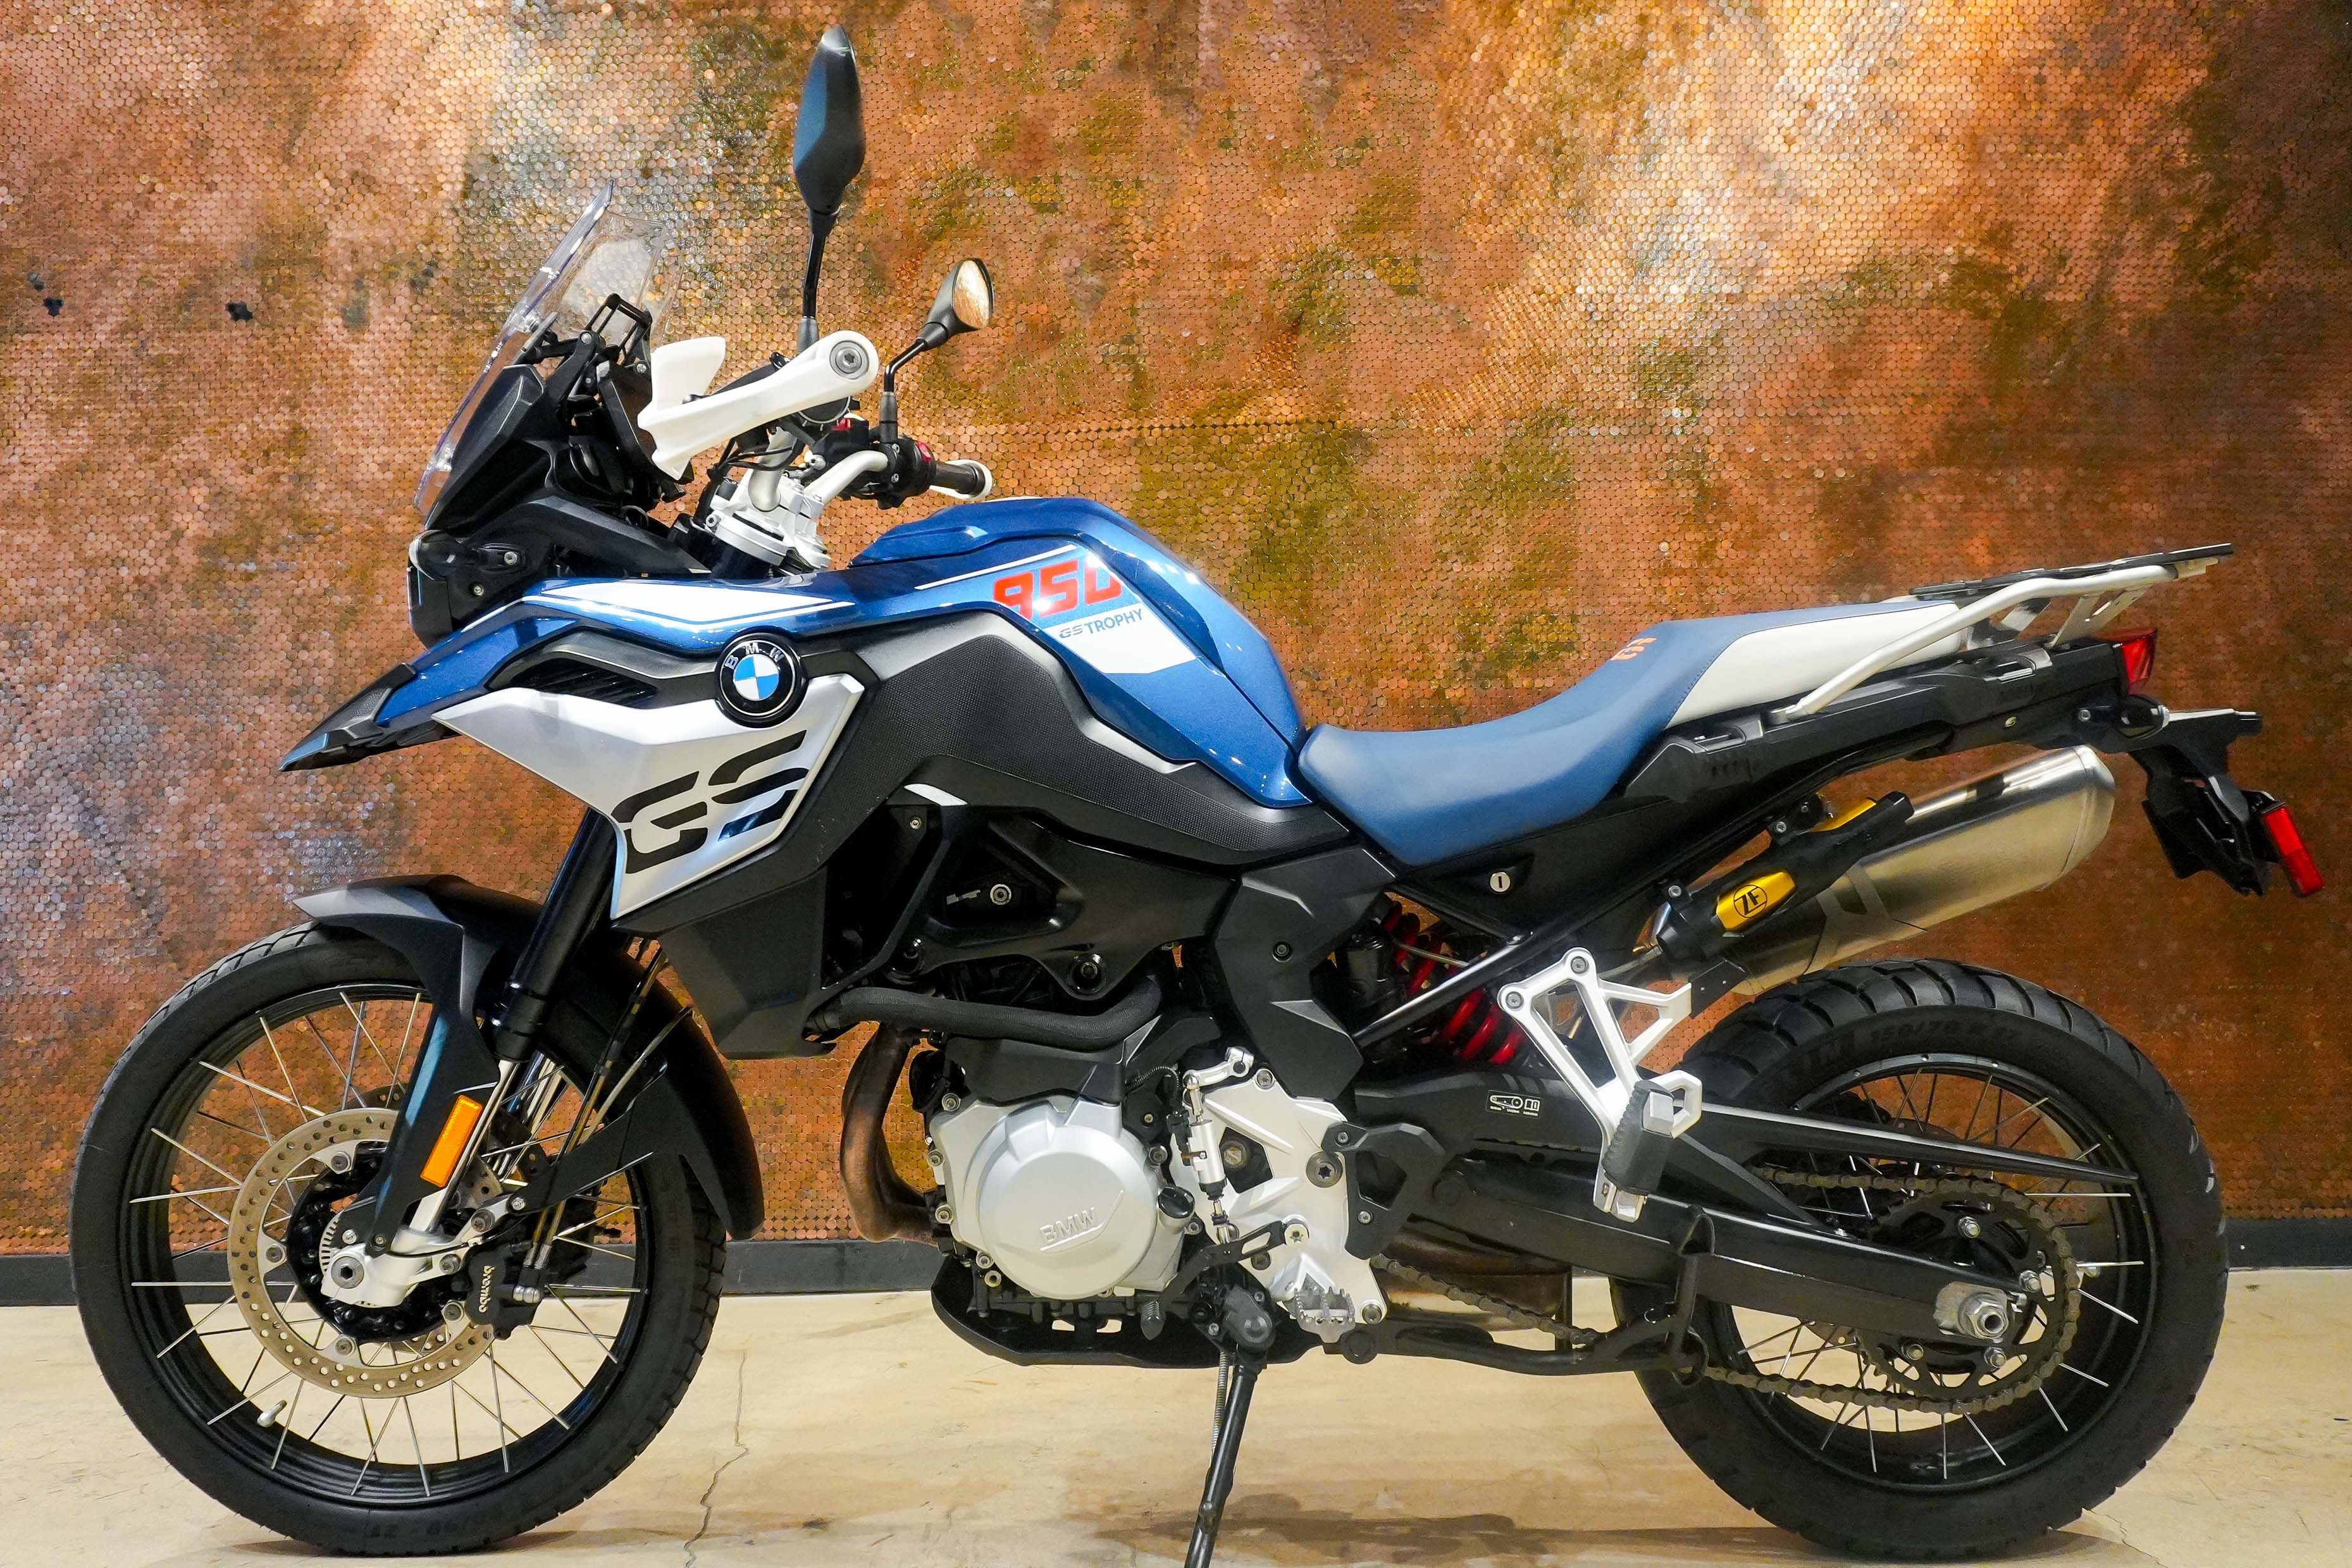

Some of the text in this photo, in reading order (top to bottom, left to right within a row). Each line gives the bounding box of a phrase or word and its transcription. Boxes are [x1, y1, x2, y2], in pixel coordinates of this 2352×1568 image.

[1084, 608, 1144, 634] TROPHY
[724, 642, 784, 670] BMW
[610, 730, 809, 874] GS
[1735, 887, 1765, 916] ZF
[1039, 1206, 1095, 1243] BMW
[478, 1265, 495, 1313] brembo
